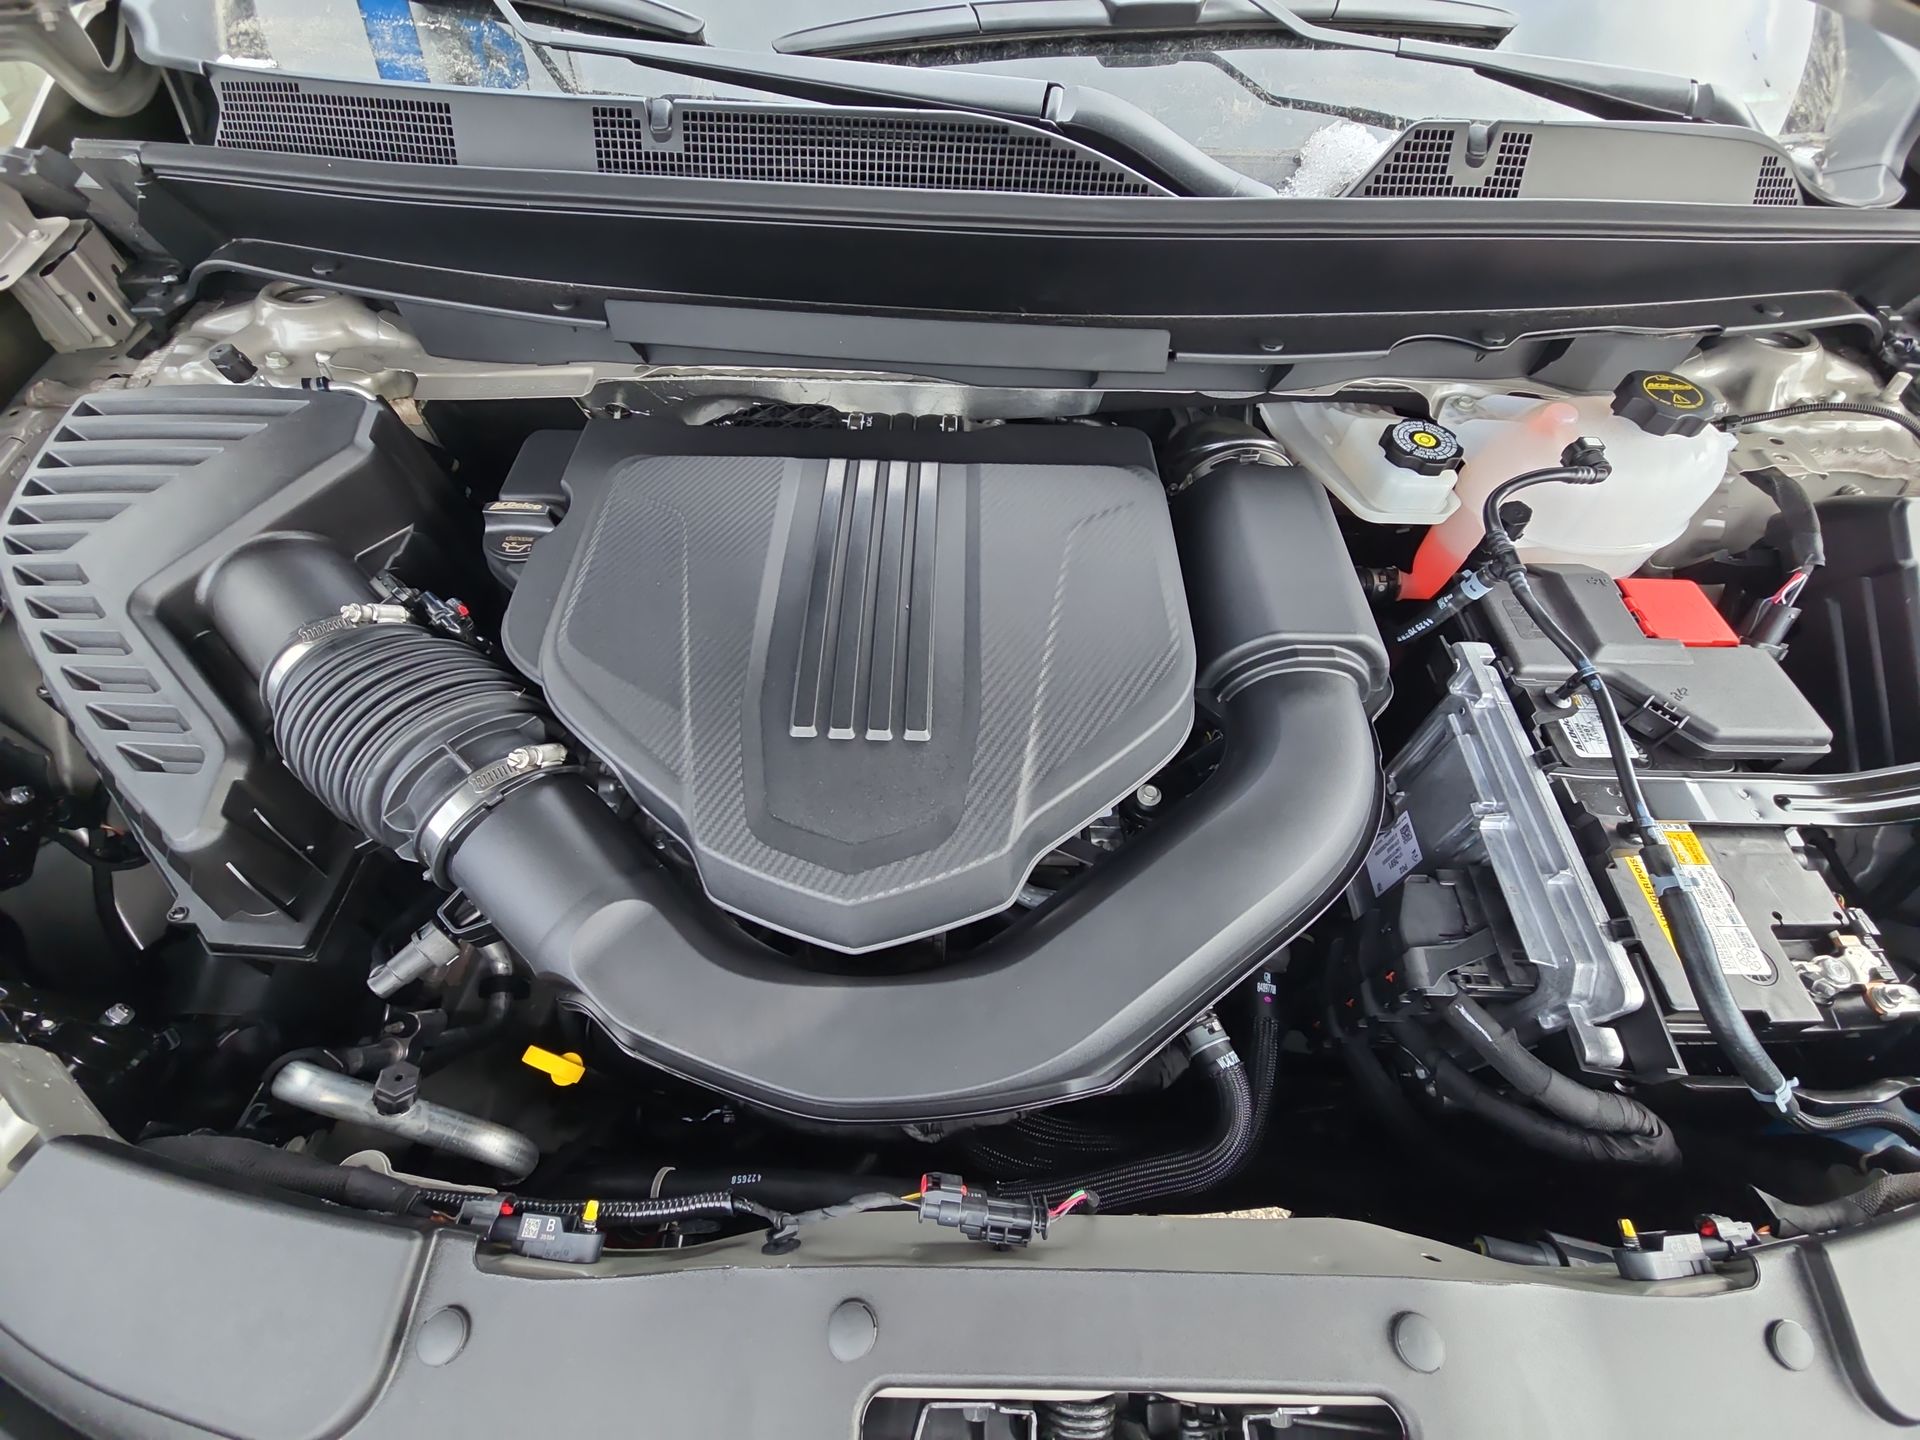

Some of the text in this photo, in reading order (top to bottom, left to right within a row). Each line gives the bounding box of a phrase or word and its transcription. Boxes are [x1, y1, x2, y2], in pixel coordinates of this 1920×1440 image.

[488, 501, 543, 511] ACDelco
[1562, 717, 1587, 753] ACDelc
[546, 1218, 556, 1232] B
